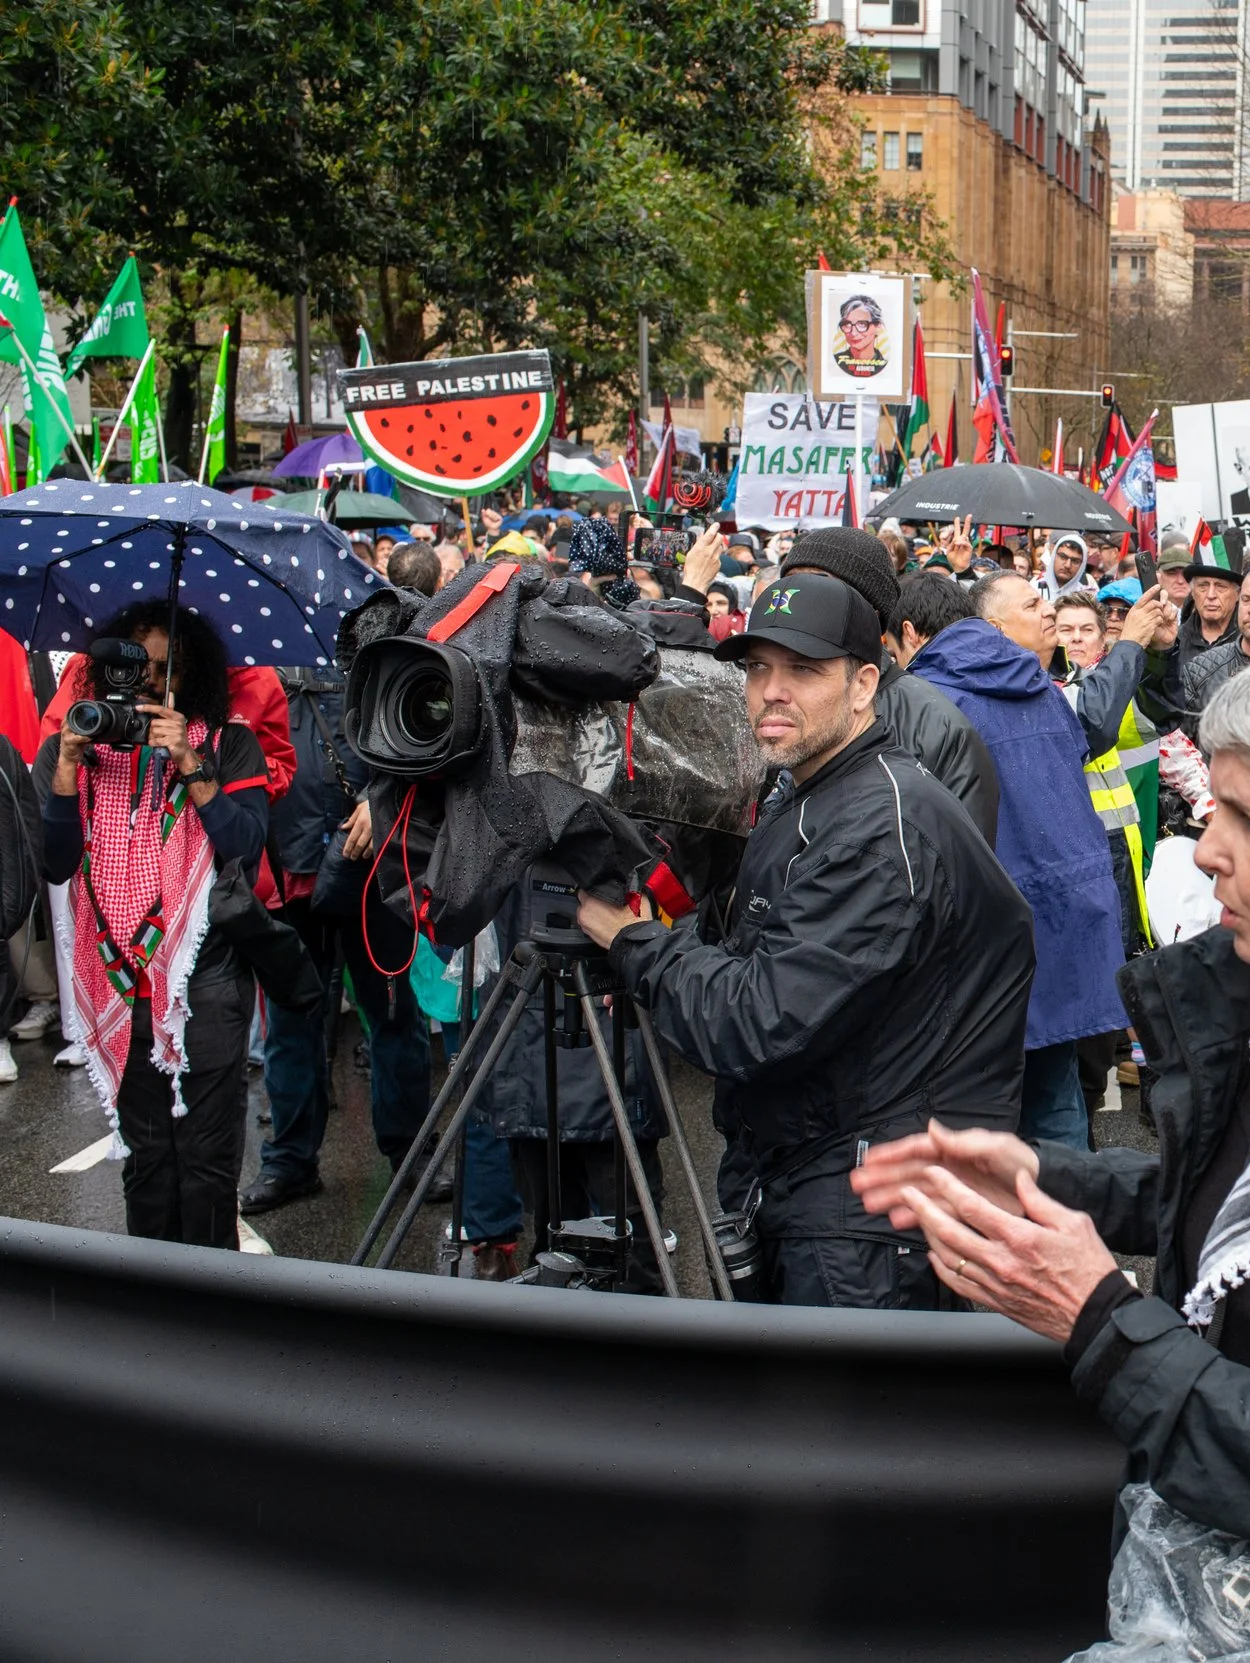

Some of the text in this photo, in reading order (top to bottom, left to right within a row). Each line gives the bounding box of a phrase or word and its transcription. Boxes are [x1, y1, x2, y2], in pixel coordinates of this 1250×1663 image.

[346, 370, 544, 403] FREE PALESTINE
[767, 402, 857, 432] SAVE
[740, 445, 873, 475] MASAFER
[915, 502, 960, 511] INDUSTRIE
[542, 882, 566, 893] Arrow
